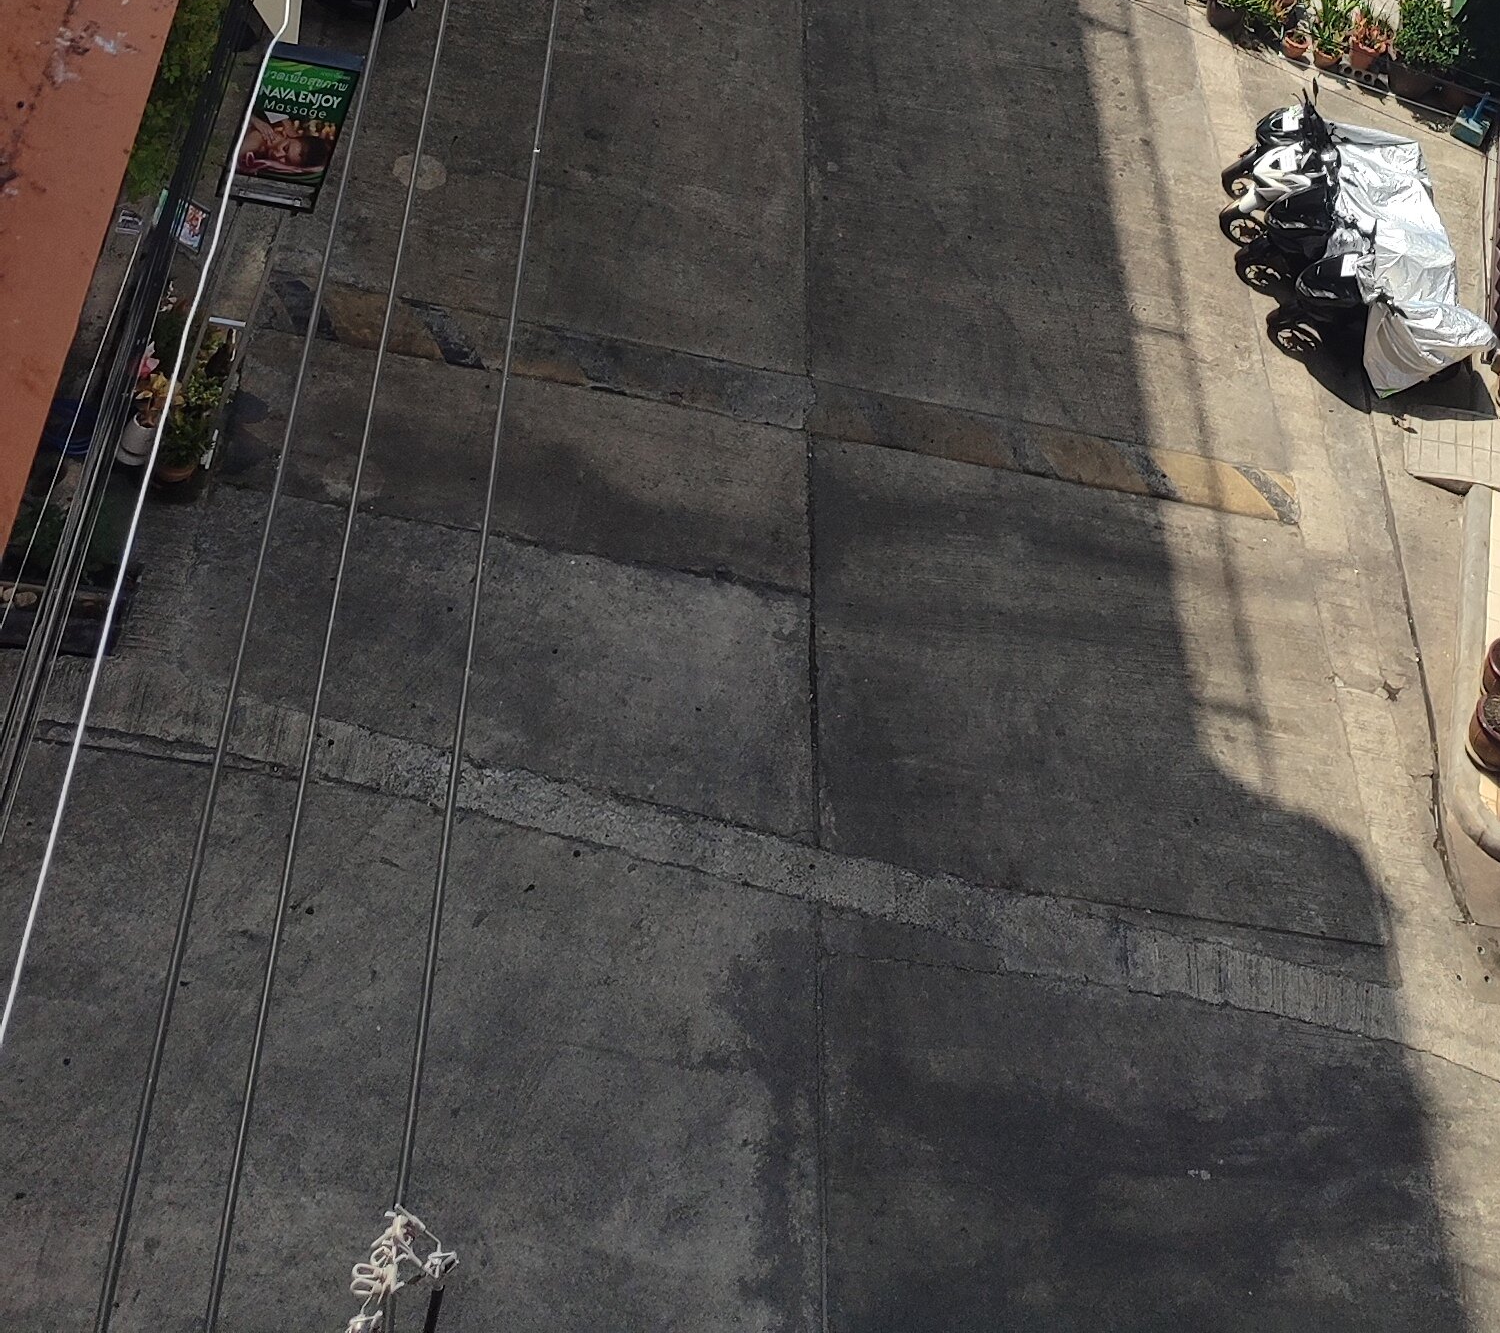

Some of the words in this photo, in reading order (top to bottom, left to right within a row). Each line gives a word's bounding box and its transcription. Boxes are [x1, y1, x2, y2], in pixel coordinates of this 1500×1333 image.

[260, 84, 296, 101] NAVA
[298, 91, 342, 109] ENJOY
[263, 99, 326, 119] Massage
